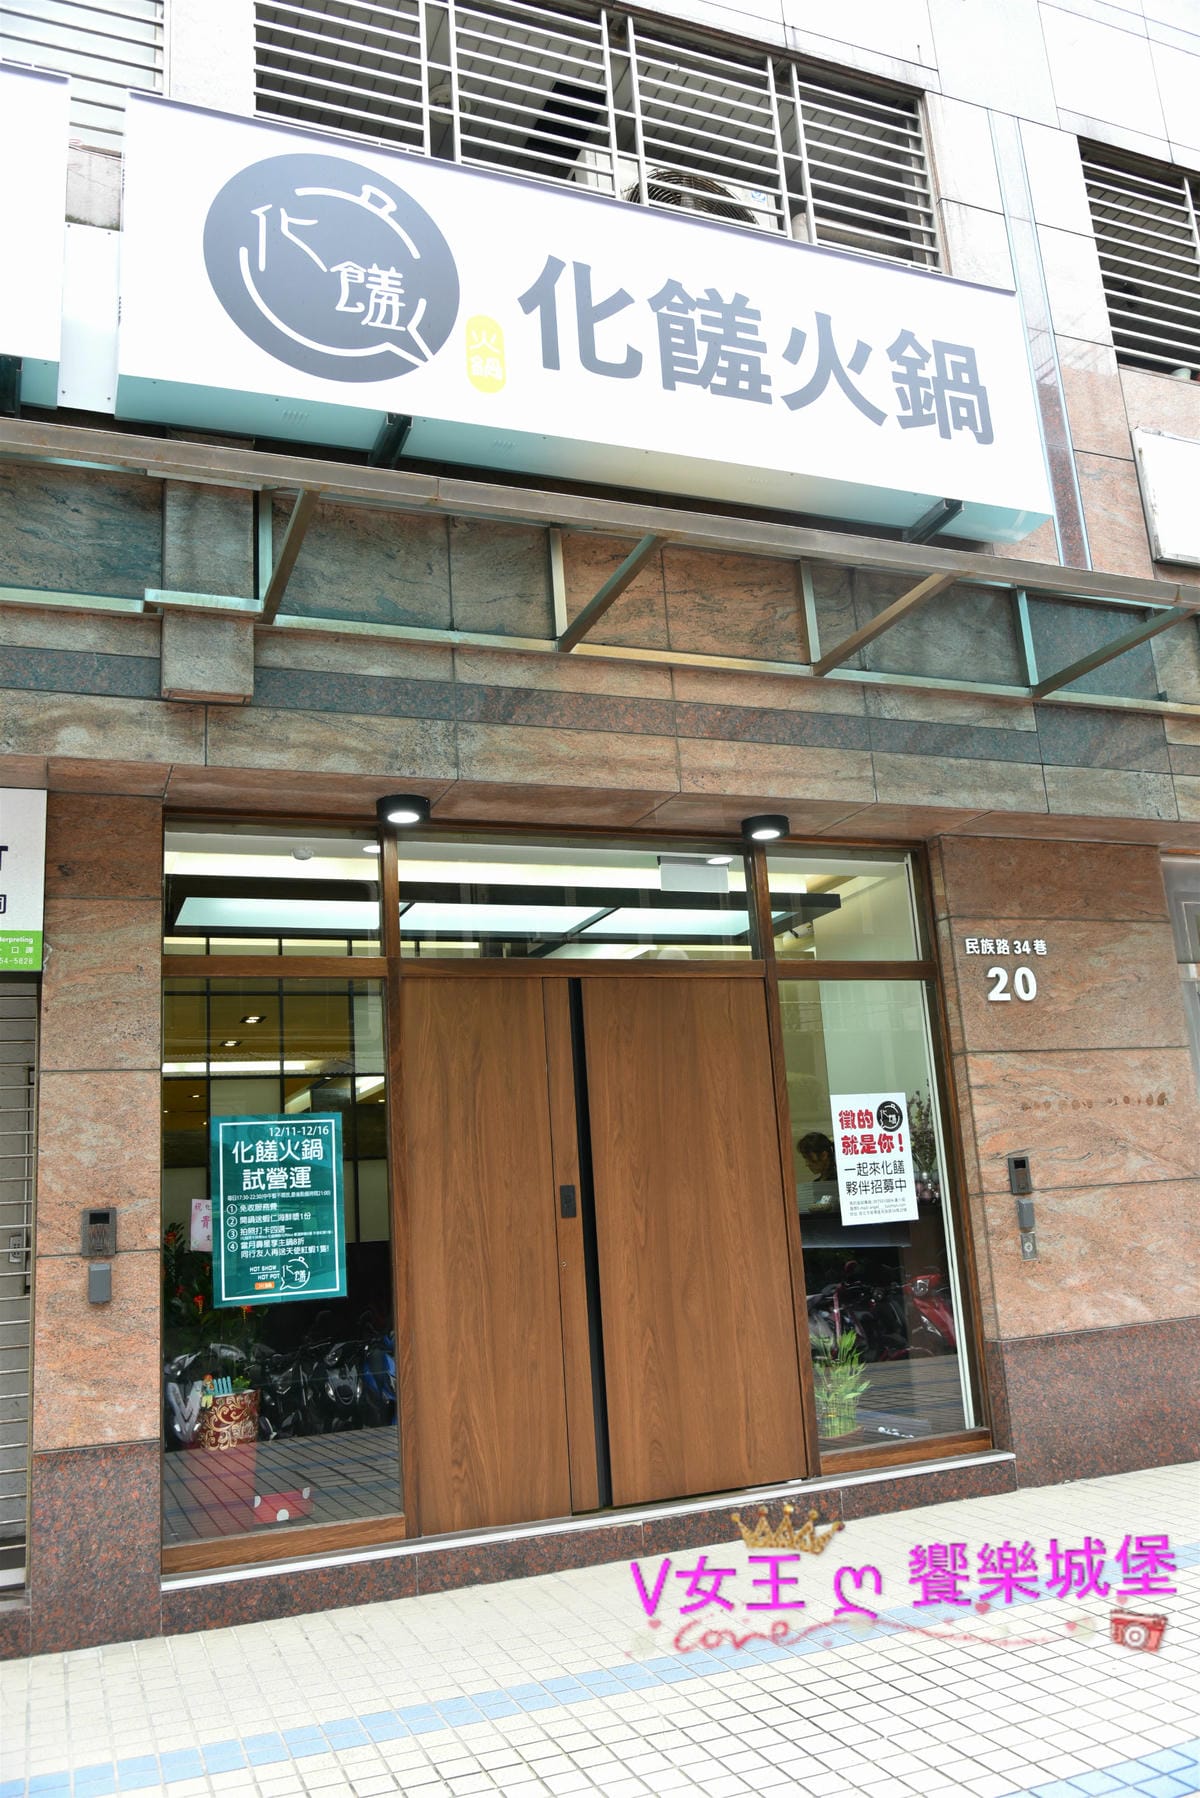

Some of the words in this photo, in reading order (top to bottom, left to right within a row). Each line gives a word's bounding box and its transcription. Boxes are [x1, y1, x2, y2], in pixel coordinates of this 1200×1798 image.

[469, 329, 503, 380] 火鍋
[517, 254, 995, 445] 化饈火鍋
[986, 966, 1037, 1002] 20
[269, 1126, 329, 1137] 12/11-12/16
[838, 1109, 874, 1130] 徵的
[232, 1139, 324, 1164] 化饈火鍋
[242, 1166, 312, 1191] 試營運
[845, 1178, 907, 1196] 夥伴招募中
